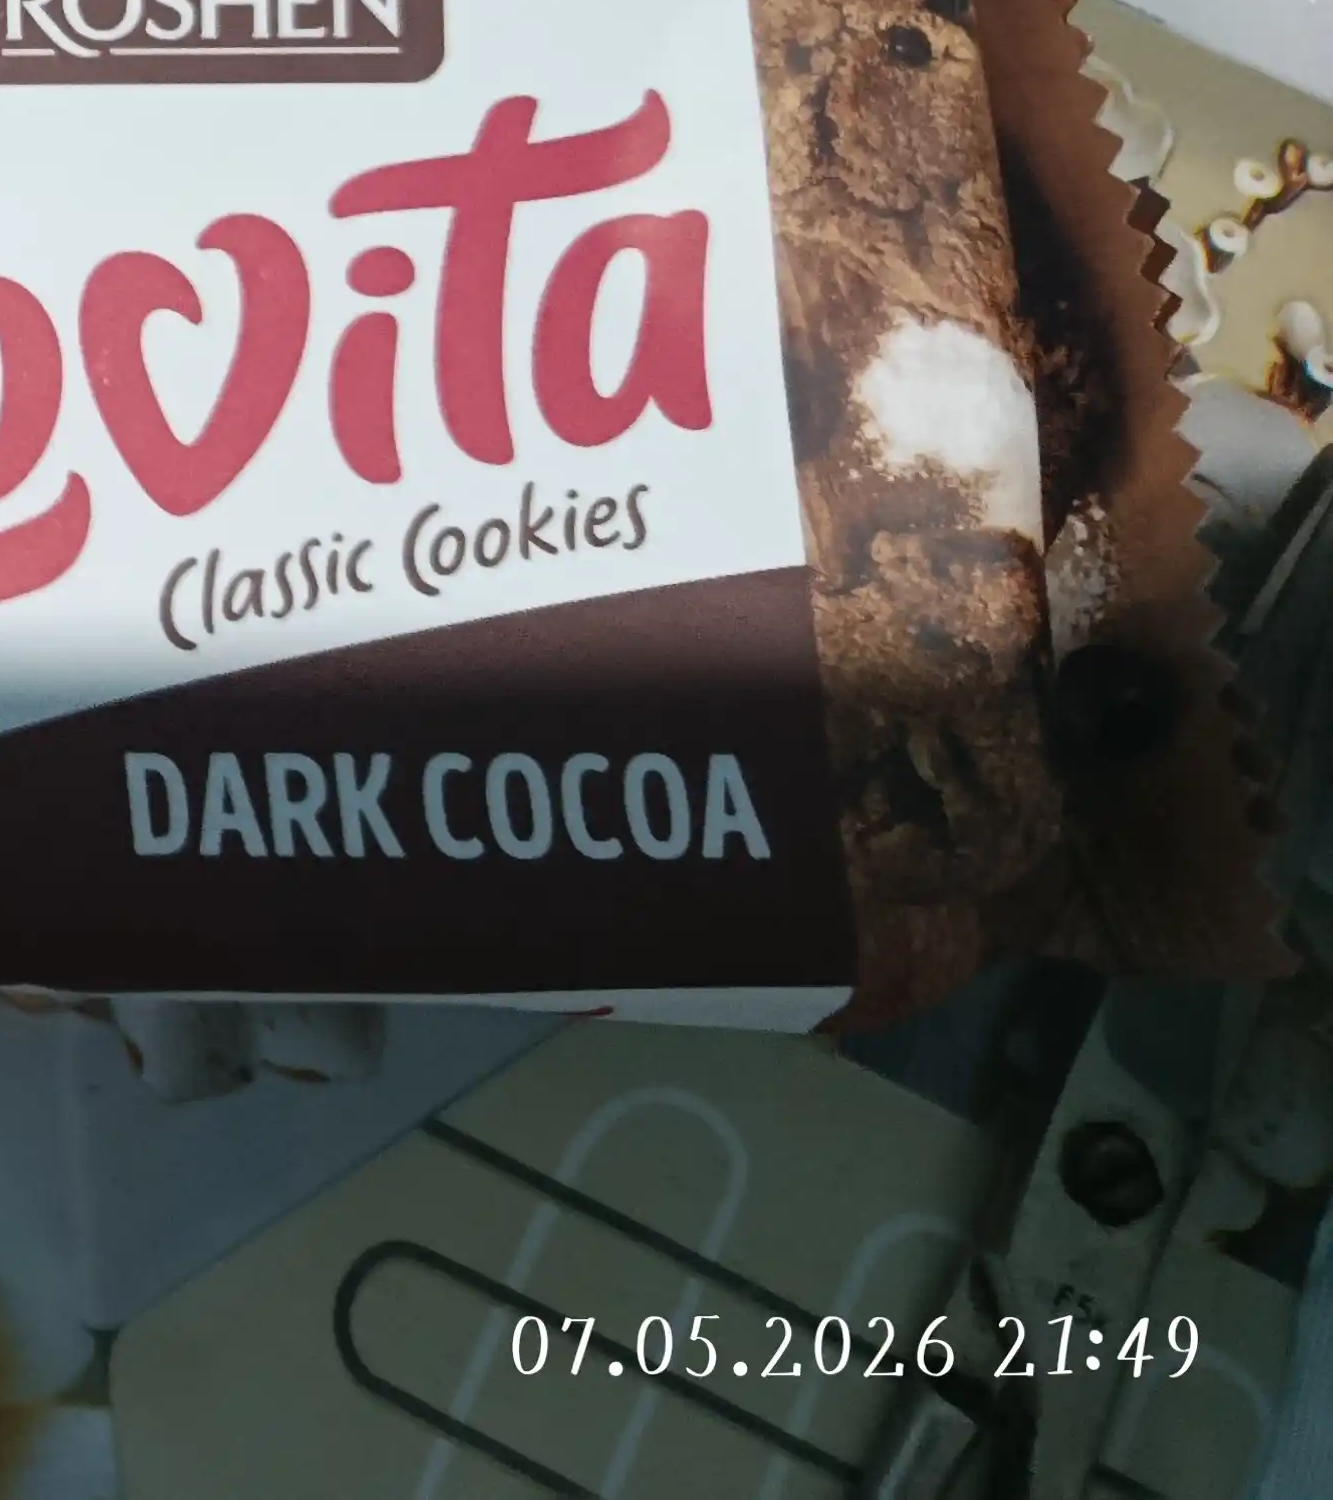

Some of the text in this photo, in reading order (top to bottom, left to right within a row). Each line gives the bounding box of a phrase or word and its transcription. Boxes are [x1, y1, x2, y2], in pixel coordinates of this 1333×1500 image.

[159, 480, 650, 653] Classic Cookies
[123, 751, 772, 861] DARK COCOA
